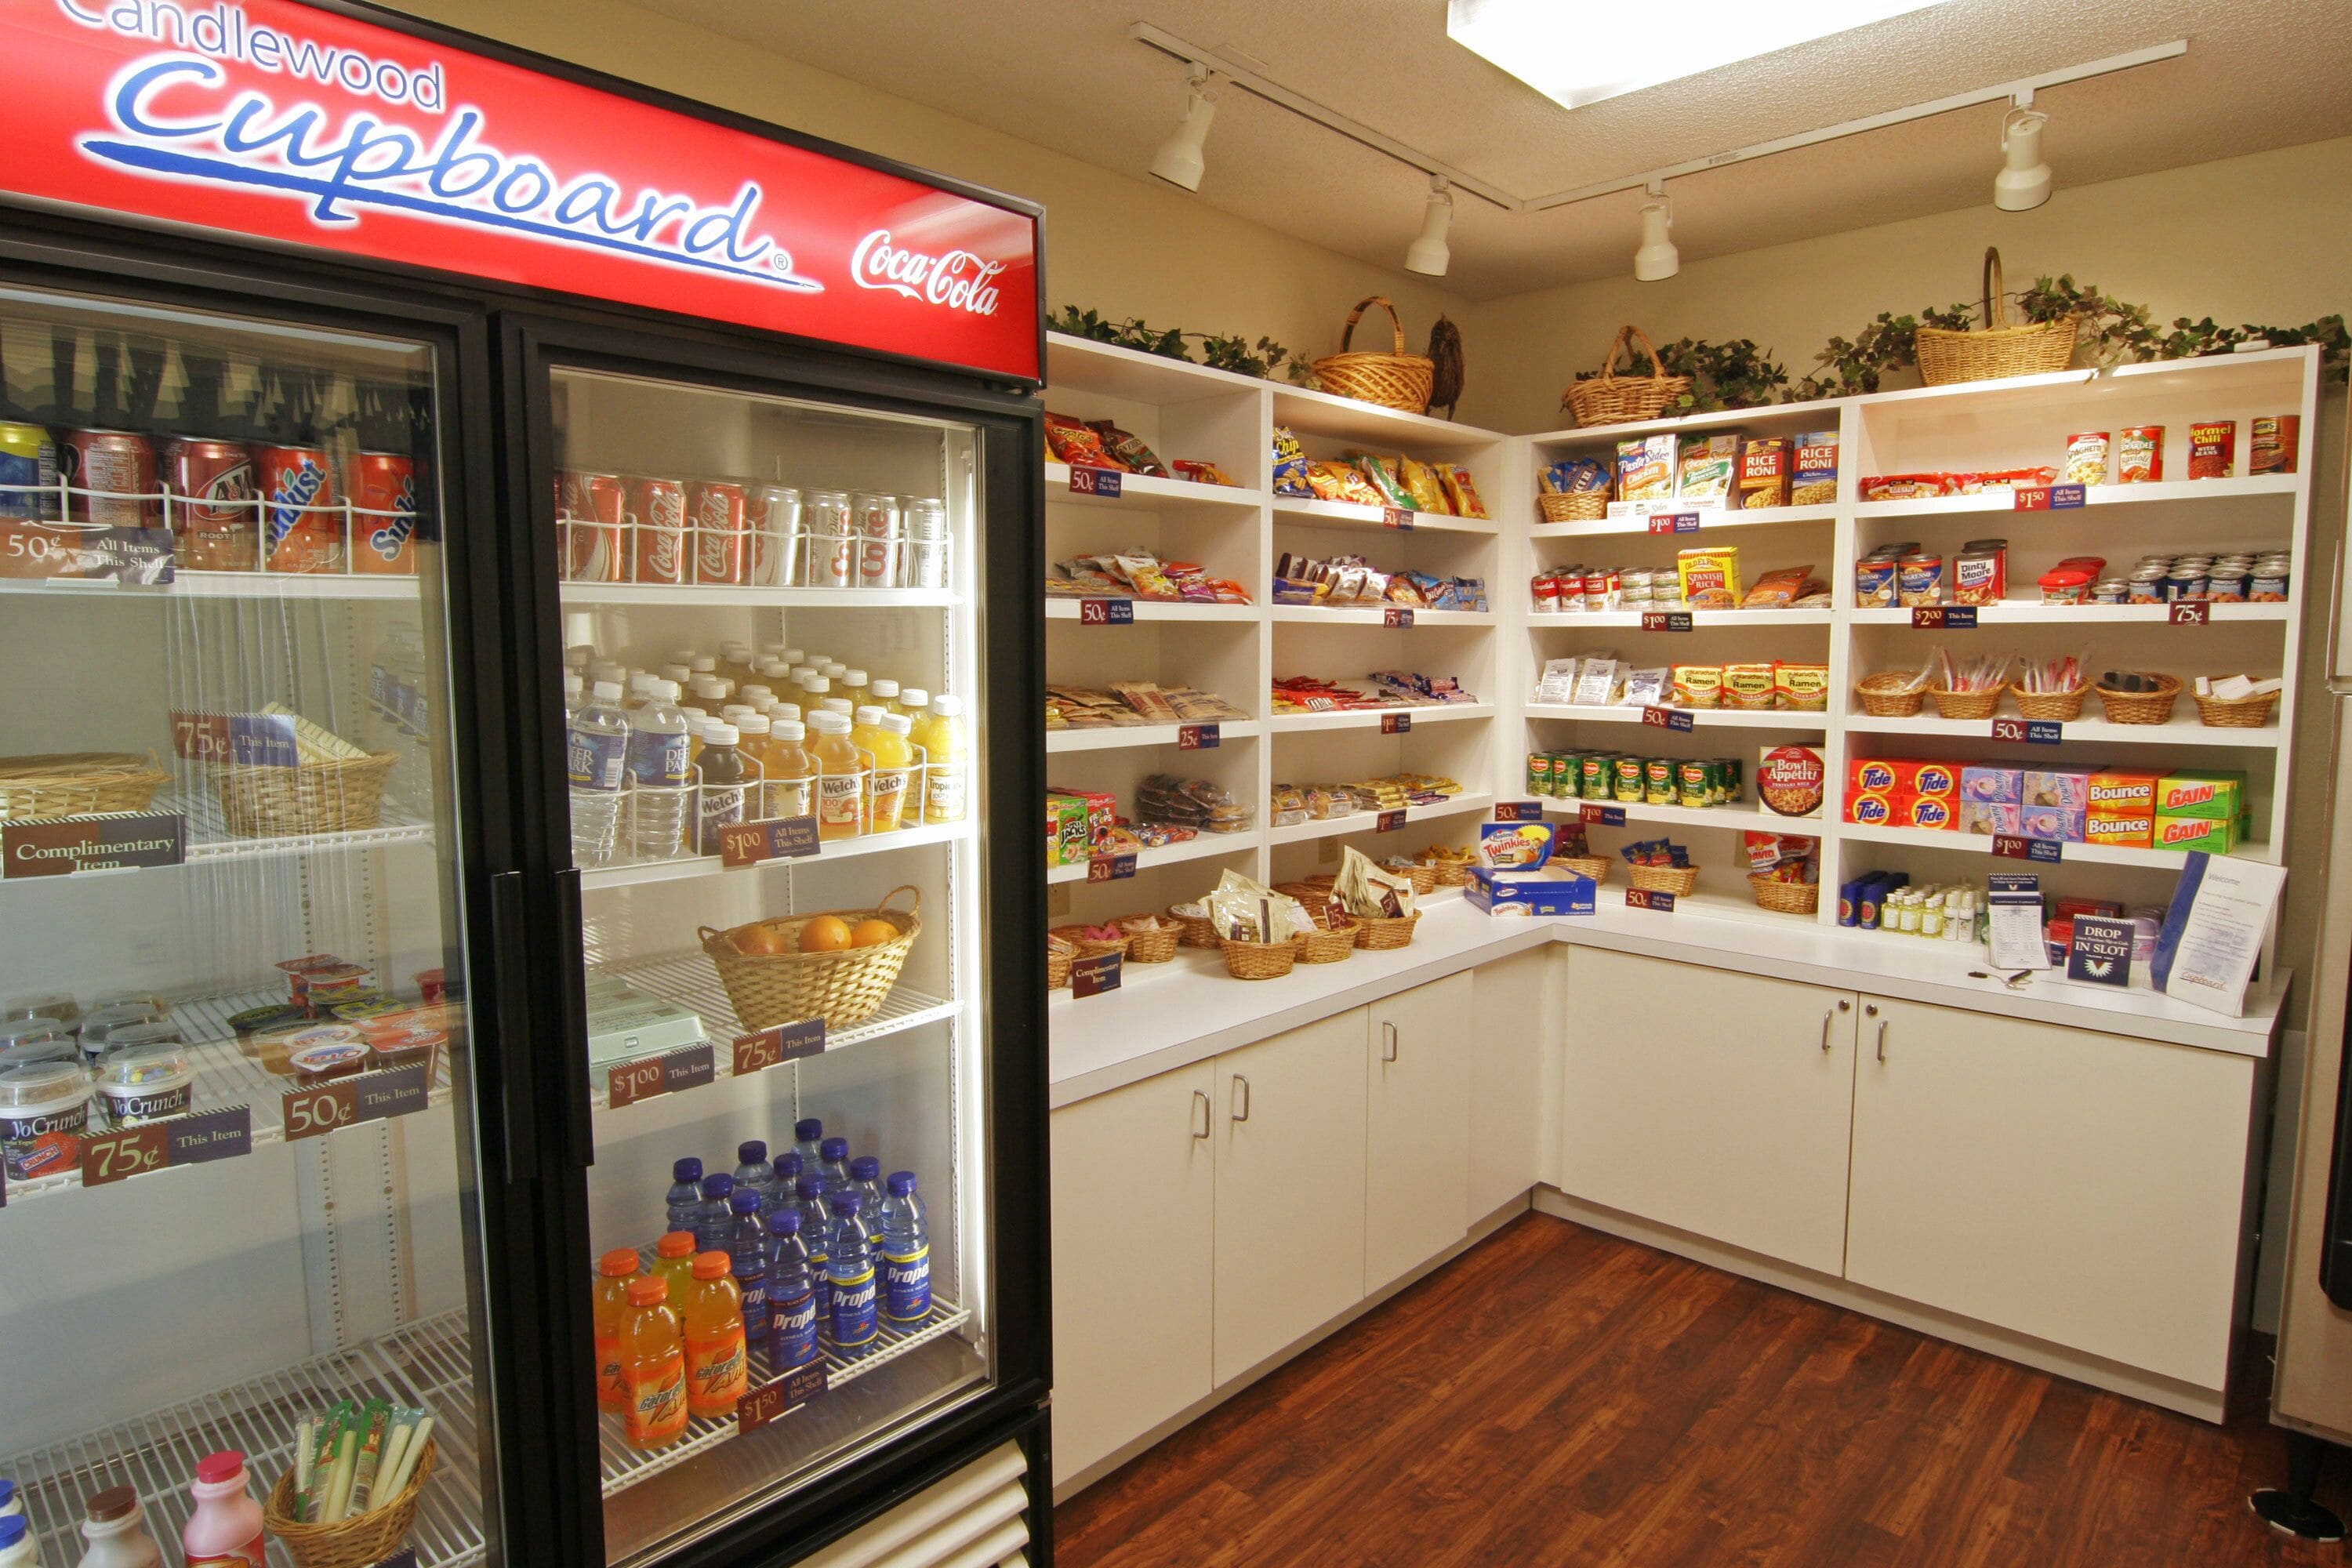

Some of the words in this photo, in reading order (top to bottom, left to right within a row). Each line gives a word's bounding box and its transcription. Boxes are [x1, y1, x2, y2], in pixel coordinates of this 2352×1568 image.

[851, 229, 1006, 316] Coca-Cola
[2194, 434, 2221, 444] Chili
[1619, 457, 1646, 474] Pasta
[1645, 448, 1670, 464] Sides
[1747, 455, 1777, 466] RICE
[1800, 447, 1832, 458] RICE
[2122, 454, 2150, 463] Ravioli
[1746, 465, 1776, 477] RONI
[1800, 459, 1832, 470] RONI
[1072, 470, 1094, 492] 50¢
[1627, 466, 1659, 484] Chicken
[7, 534, 62, 559] 50¢
[96, 539, 118, 550] All
[122, 541, 160, 554] Items
[860, 511, 888, 578] Coke
[94, 554, 125, 567] This
[129, 557, 165, 570] Shelf
[1961, 561, 1987, 573] Dinty
[1688, 572, 1723, 586] SPANISH
[1962, 568, 1991, 580] Moore
[1083, 604, 1105, 622] 50¢
[2175, 604, 2202, 622] 75¢
[1686, 677, 1715, 686] Ramen
[1789, 679, 1820, 688] Ramen
[1645, 710, 1666, 726] 50¢
[177, 722, 229, 755] 75¢
[238, 735, 263, 749] This
[264, 736, 290, 749] Item
[1180, 730, 1199, 747] 25¢
[1994, 723, 2023, 740] 50¢
[1777, 760, 1807, 771] Bowl
[1768, 768, 1818, 782] Appétit!
[1864, 768, 1891, 789] Tide
[1921, 772, 1948, 793] Tide
[1993, 771, 2006, 802] Downy
[2060, 774, 2071, 805] Downy
[2089, 785, 2150, 800] Bounce
[2166, 785, 2215, 808] GAIN
[1497, 806, 1516, 819] 50¢
[1857, 801, 1885, 821] Tide
[1916, 804, 1945, 824] Tide
[1989, 804, 2006, 834] Downy
[775, 827, 788, 837] All
[788, 826, 810, 837] Items
[2056, 808, 2069, 840] Downy
[2088, 819, 2149, 833] Bounce
[2163, 821, 2211, 844] GAIN
[774, 838, 793, 848] This
[793, 833, 813, 847] Shelf
[1061, 826, 1087, 848] JACKS
[1493, 831, 1513, 840] Hostess
[16, 836, 175, 862] Complimentary
[1484, 838, 1530, 858] Twinkies
[74, 858, 120, 871] Item
[2209, 873, 2241, 887] Welcome
[1628, 891, 1647, 906] 50¢
[1494, 904, 1519, 916] Twinkies
[2085, 926, 2122, 939] DROP
[2075, 942, 2091, 952] IN
[2092, 944, 2128, 956] SLOT
[1076, 962, 1120, 978] Complimentary
[1093, 975, 1105, 984] Item
[739, 1040, 776, 1069] 75¢
[786, 1039, 802, 1049] This
[804, 1033, 821, 1045] Item
[669, 1068, 688, 1080] This
[690, 1061, 710, 1074] Item
[112, 1087, 183, 1117] YoCrunch
[289, 1095, 352, 1134] 50¢
[365, 1090, 391, 1106] This
[393, 1085, 419, 1100] Item
[12, 1105, 85, 1141] YoCrunch
[22, 1145, 58, 1170] CRUNCH
[91, 1134, 160, 1177] 75¢
[177, 1133, 205, 1149] This
[207, 1127, 242, 1144] Item
[790, 1377, 802, 1388] All
[802, 1370, 820, 1382] Items
[789, 1387, 805, 1399] This
[805, 1379, 823, 1392] Shelf
